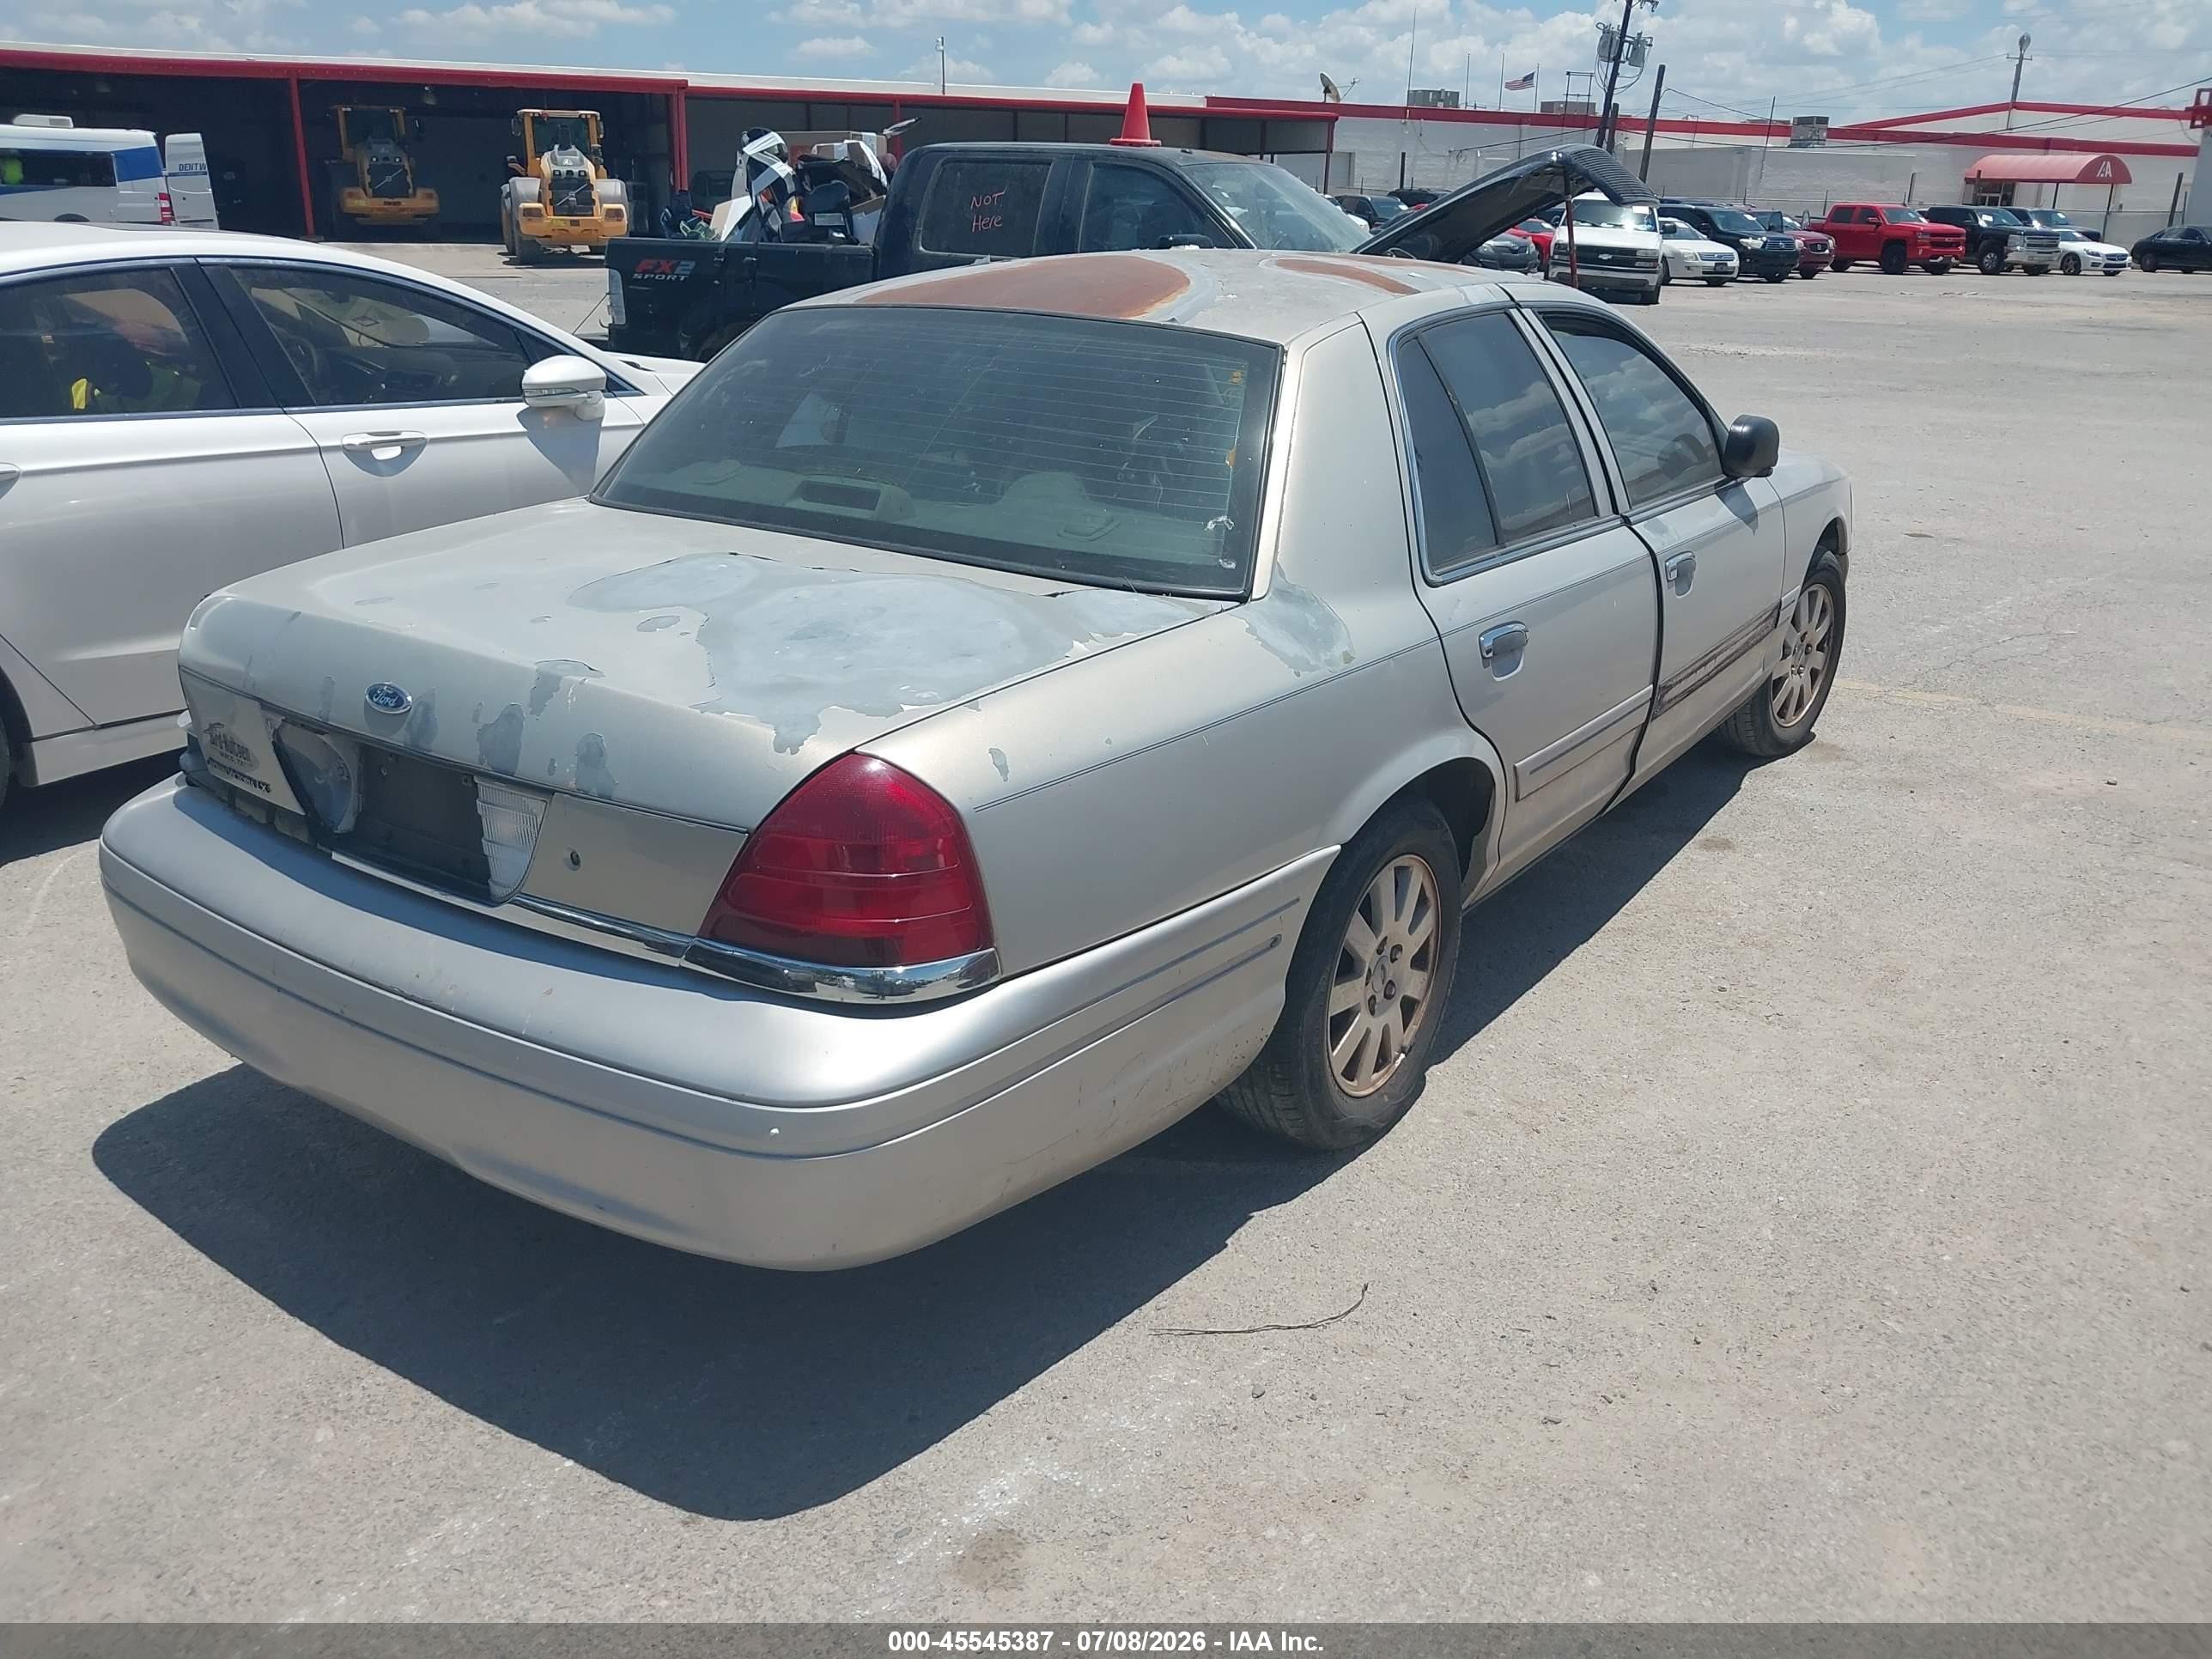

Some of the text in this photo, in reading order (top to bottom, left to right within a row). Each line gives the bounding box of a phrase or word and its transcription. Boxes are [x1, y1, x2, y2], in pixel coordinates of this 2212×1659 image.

[970, 185, 1008, 210] NOT
[971, 214, 1003, 233] Here
[635, 259, 696, 275] FX2
[632, 273, 690, 282] SPORT
